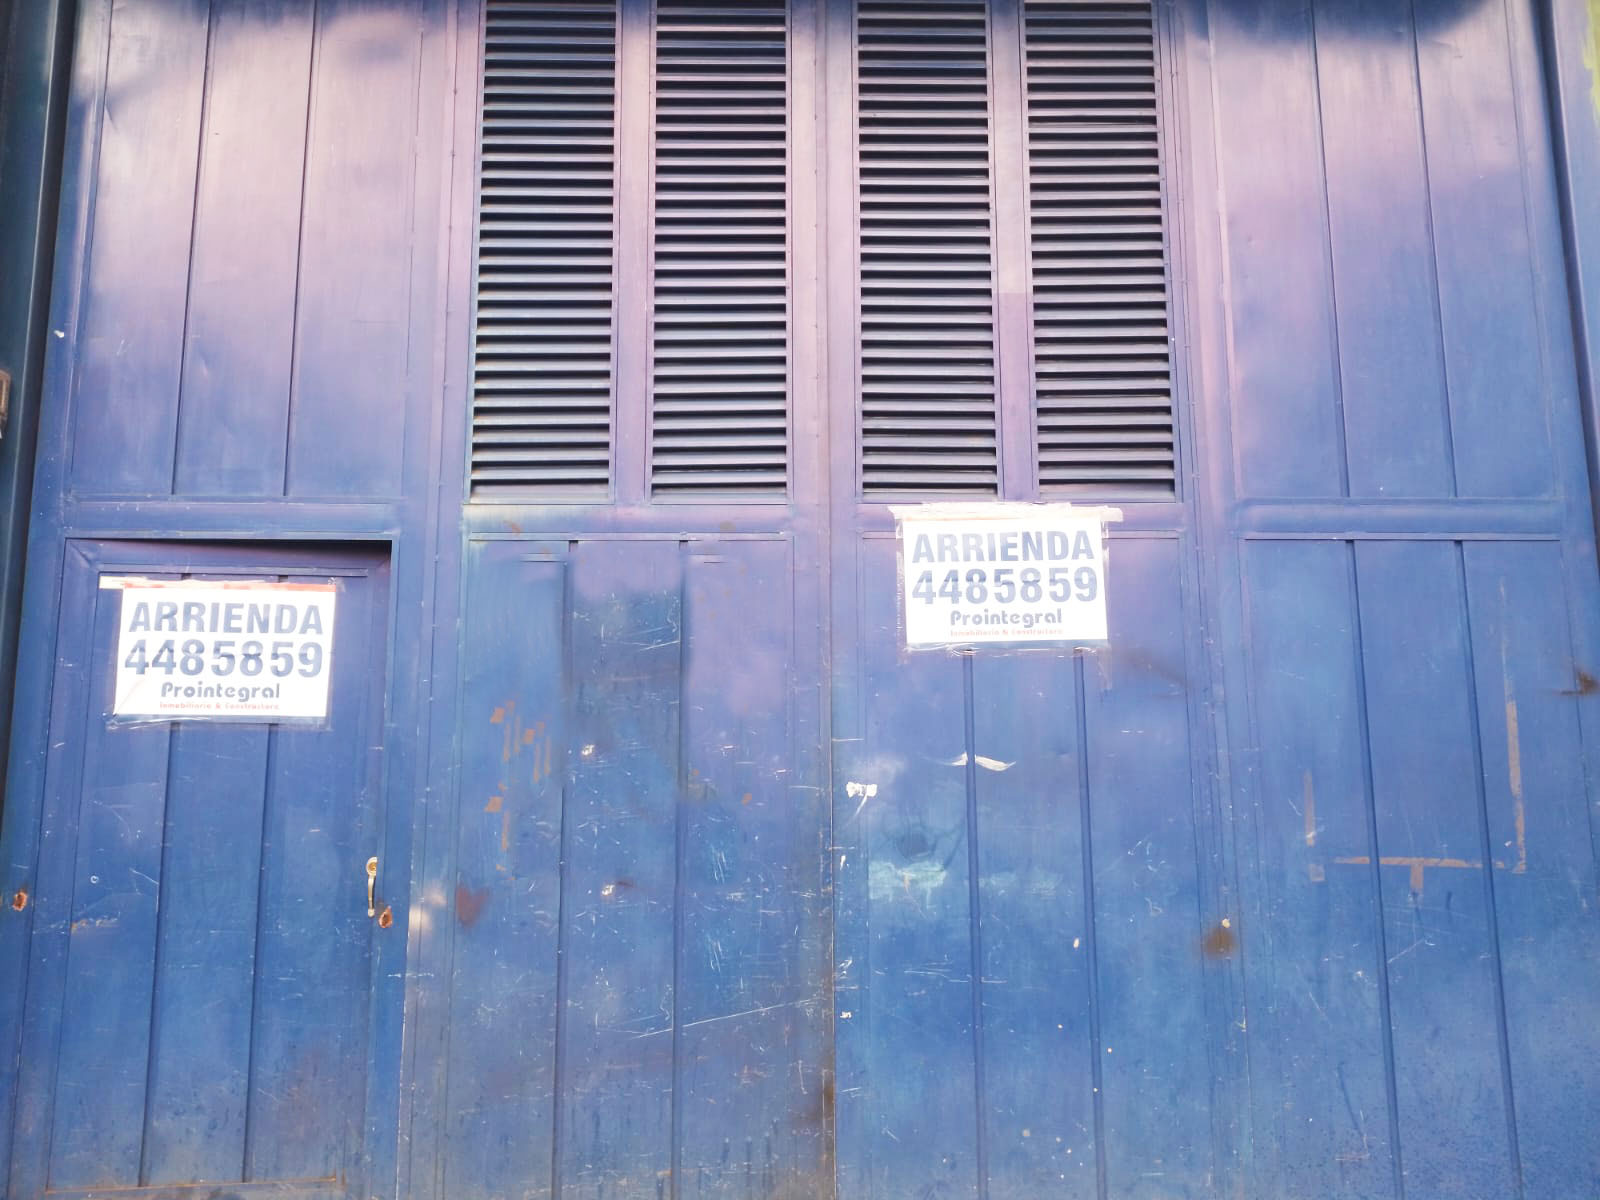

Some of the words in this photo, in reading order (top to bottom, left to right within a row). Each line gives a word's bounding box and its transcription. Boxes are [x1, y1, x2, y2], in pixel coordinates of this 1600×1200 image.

[912, 530, 1094, 563] ARRIENDA
[912, 566, 1097, 604] 4485859
[128, 601, 323, 635] ARRIENDA
[950, 608, 1062, 628] Prointegral
[124, 639, 323, 677] 4485859
[161, 681, 280, 702] Prointegral
